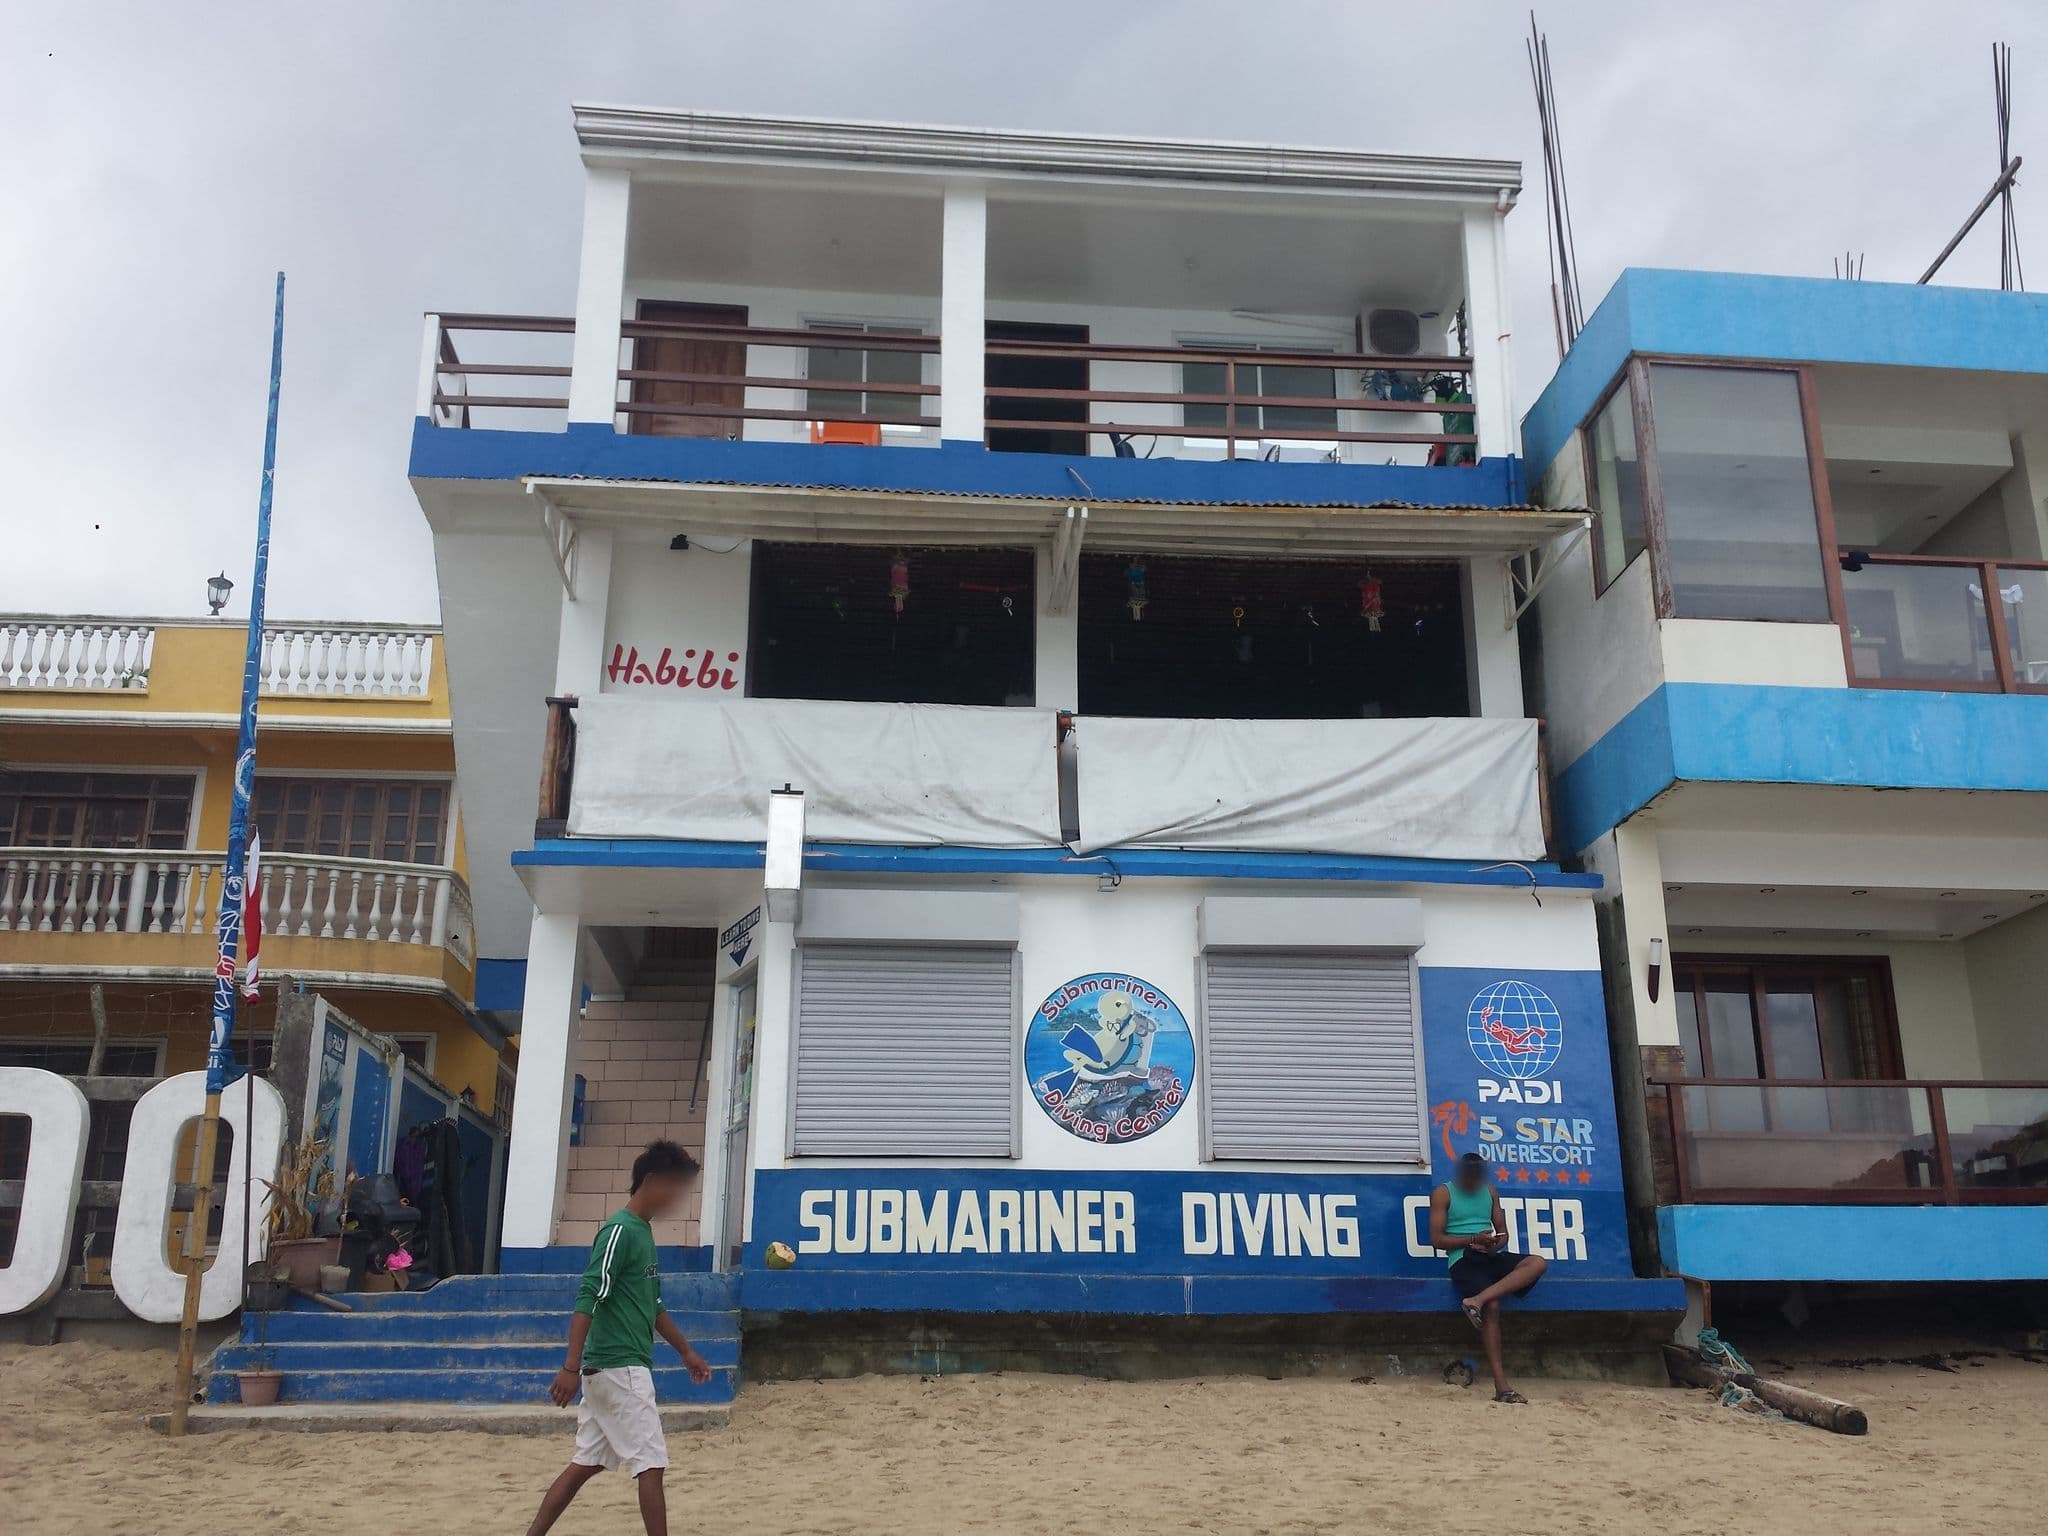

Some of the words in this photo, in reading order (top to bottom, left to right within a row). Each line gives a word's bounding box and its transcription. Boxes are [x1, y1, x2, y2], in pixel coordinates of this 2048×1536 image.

[607, 643, 740, 691] Habibi
[1041, 977, 1168, 1021] Submariner
[1043, 1088, 1108, 1142] Diving
[1115, 1078, 1184, 1137] Center
[1478, 1079, 1563, 1104] PADI
[1479, 1116, 1503, 1142] 5
[1515, 1117, 1593, 1145] STAR
[799, 1189, 1136, 1254] SUBMARINER
[1182, 1192, 1361, 1258] DIVING
[1403, 1195, 1587, 1261] CTER
